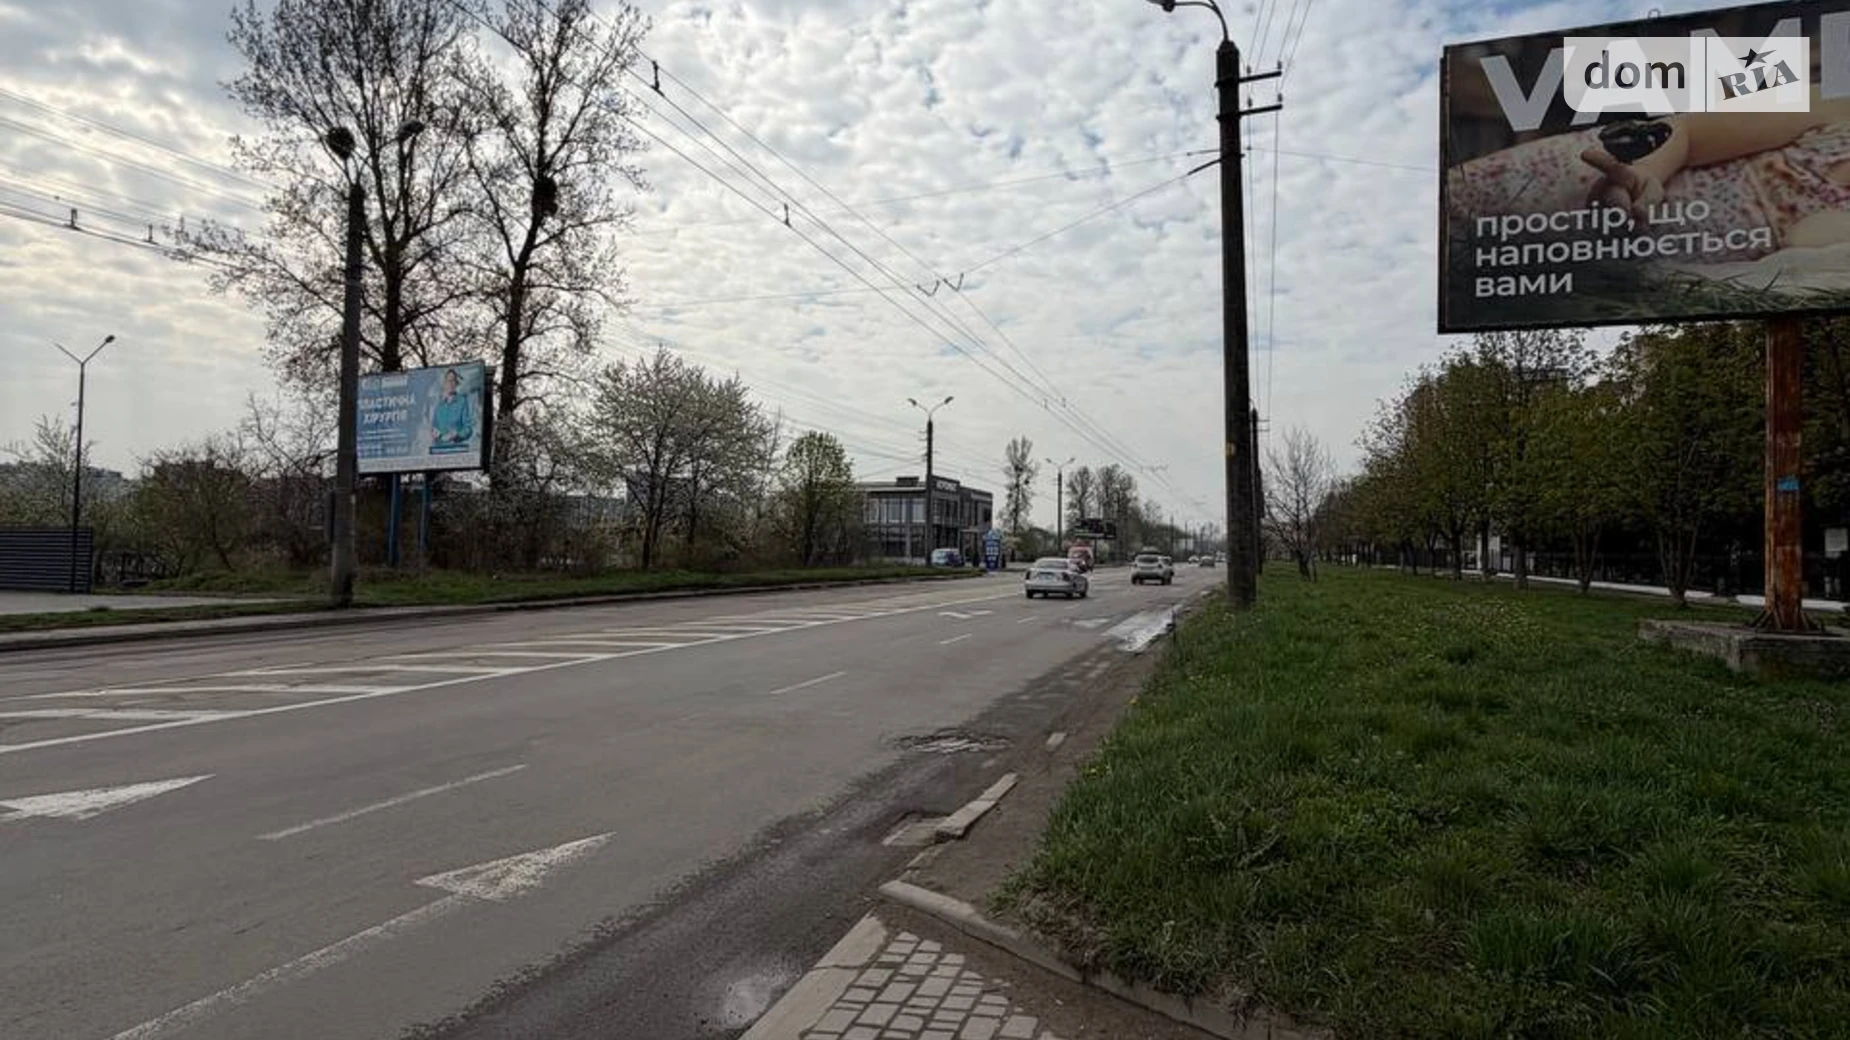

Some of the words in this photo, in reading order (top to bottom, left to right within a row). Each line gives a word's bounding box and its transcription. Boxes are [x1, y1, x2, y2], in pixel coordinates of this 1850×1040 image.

[1476, 201, 1635, 241] простір,
[1649, 201, 1710, 226] що
[1476, 227, 1772, 267] наповнюється
[1475, 273, 1573, 297] вами
